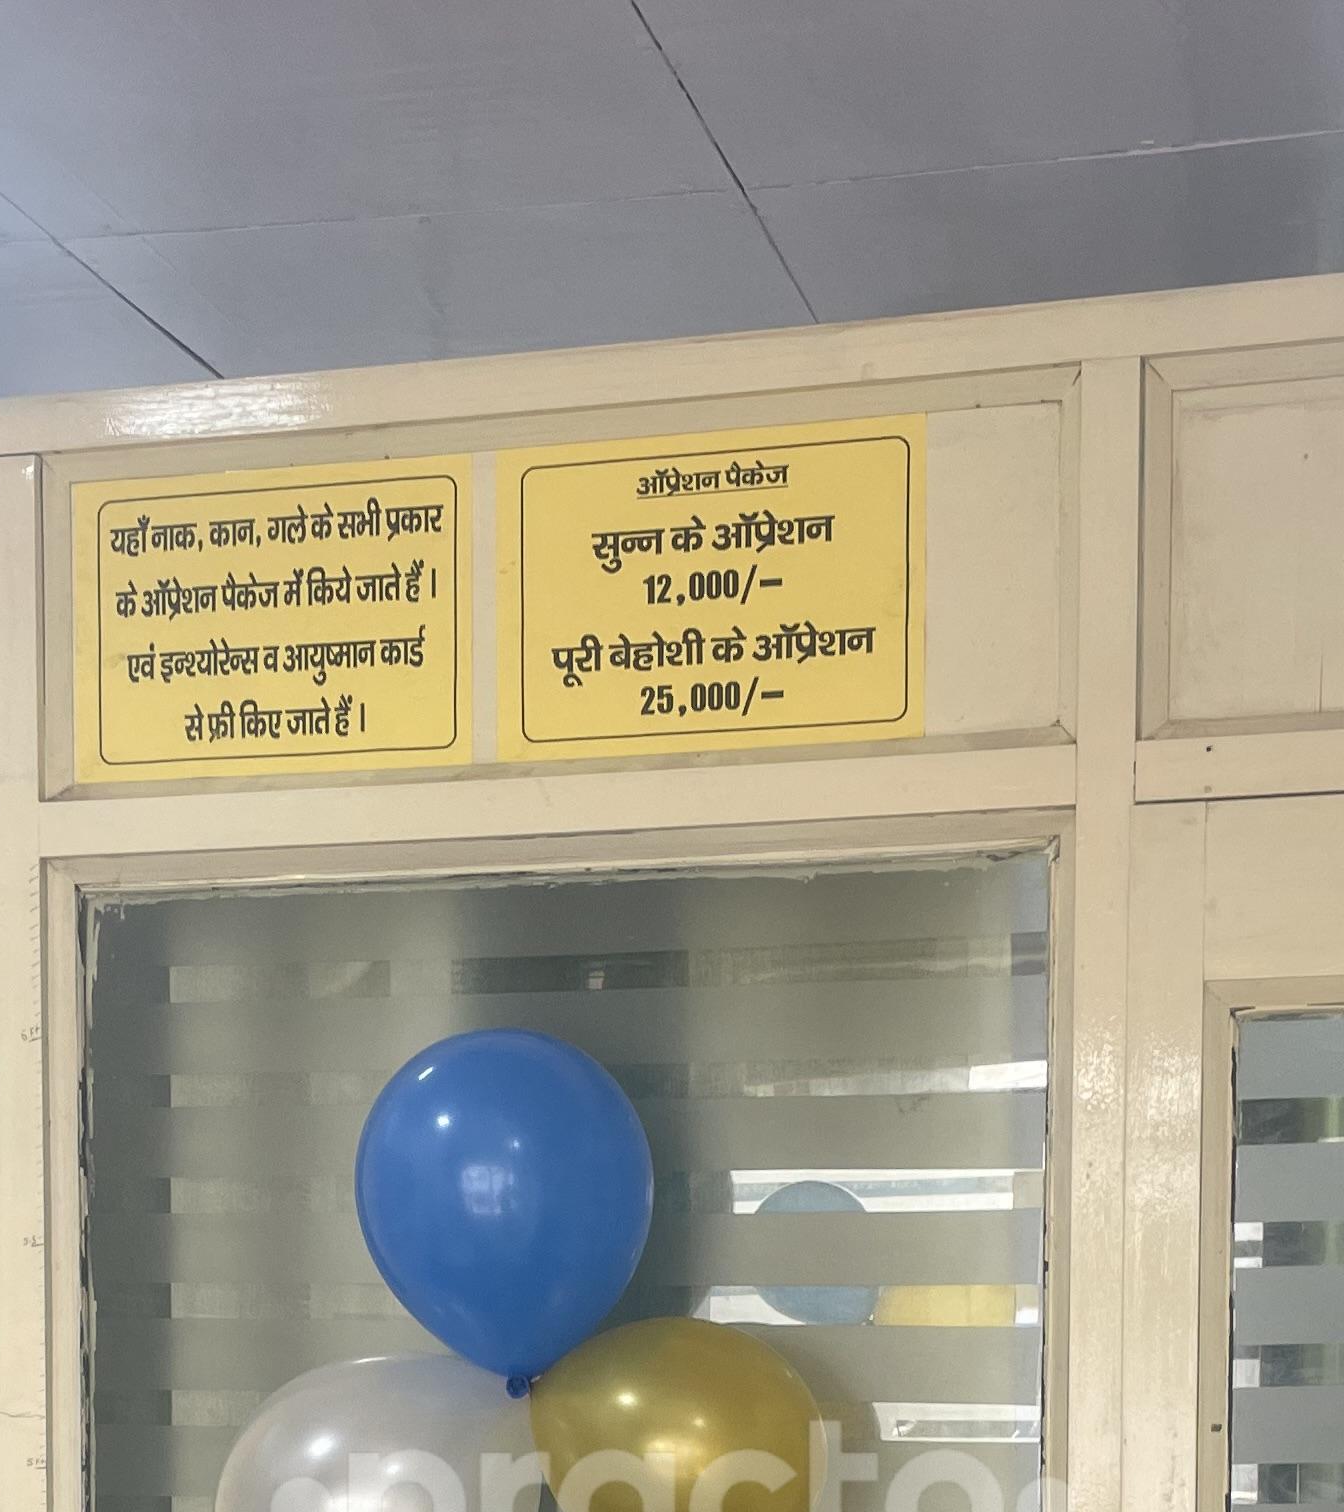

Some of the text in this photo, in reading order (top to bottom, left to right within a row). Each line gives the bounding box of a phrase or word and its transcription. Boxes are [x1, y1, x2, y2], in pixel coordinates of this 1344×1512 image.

[636, 461, 789, 496] ऑप्रेशन पैकेज
[110, 498, 443, 556] यहाँ नाक, कान, गले के सभी प्रकार
[592, 510, 835, 573] सुन्न के ऑप्रेशन
[116, 580, 137, 617] के
[142, 577, 218, 620] ऑप्रेशन
[221, 572, 279, 610] पैकेज
[284, 568, 304, 606] में
[307, 566, 352, 606] किये
[355, 562, 401, 601] जाते
[643, 564, 782, 605] 12,000/-
[127, 643, 156, 682] एवं
[263, 646, 279, 672] व
[283, 640, 376, 685] आयुष्मान
[380, 625, 425, 667] कार्ड
[552, 621, 876, 687] पूरी बेहोशी के ऑप्रेशन
[185, 704, 204, 741] से
[239, 700, 282, 738] किए
[285, 696, 331, 735] जाते
[641, 677, 784, 716] 25,000/-
